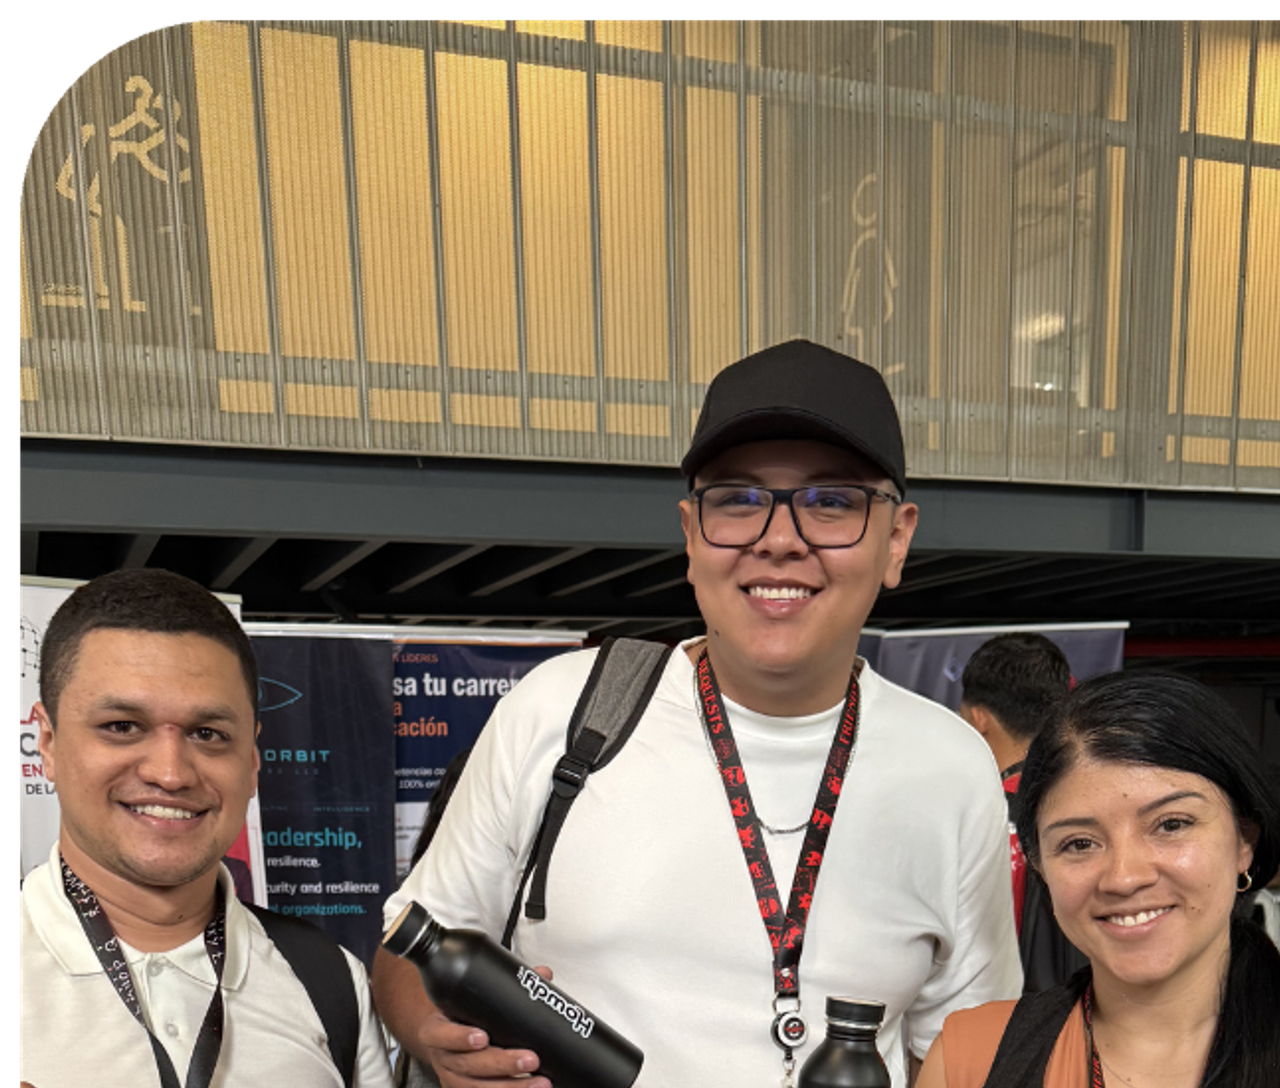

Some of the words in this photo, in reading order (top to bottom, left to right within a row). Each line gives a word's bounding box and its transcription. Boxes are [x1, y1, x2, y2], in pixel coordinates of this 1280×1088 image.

[422, 672, 447, 696] tu
[264, 749, 330, 763] ORBIT
[26, 783, 42, 795] DE
[261, 827, 362, 850] adership,
[300, 882, 322, 894] and
[326, 881, 380, 894] resilience
[521, 970, 594, 1038] Howdy
